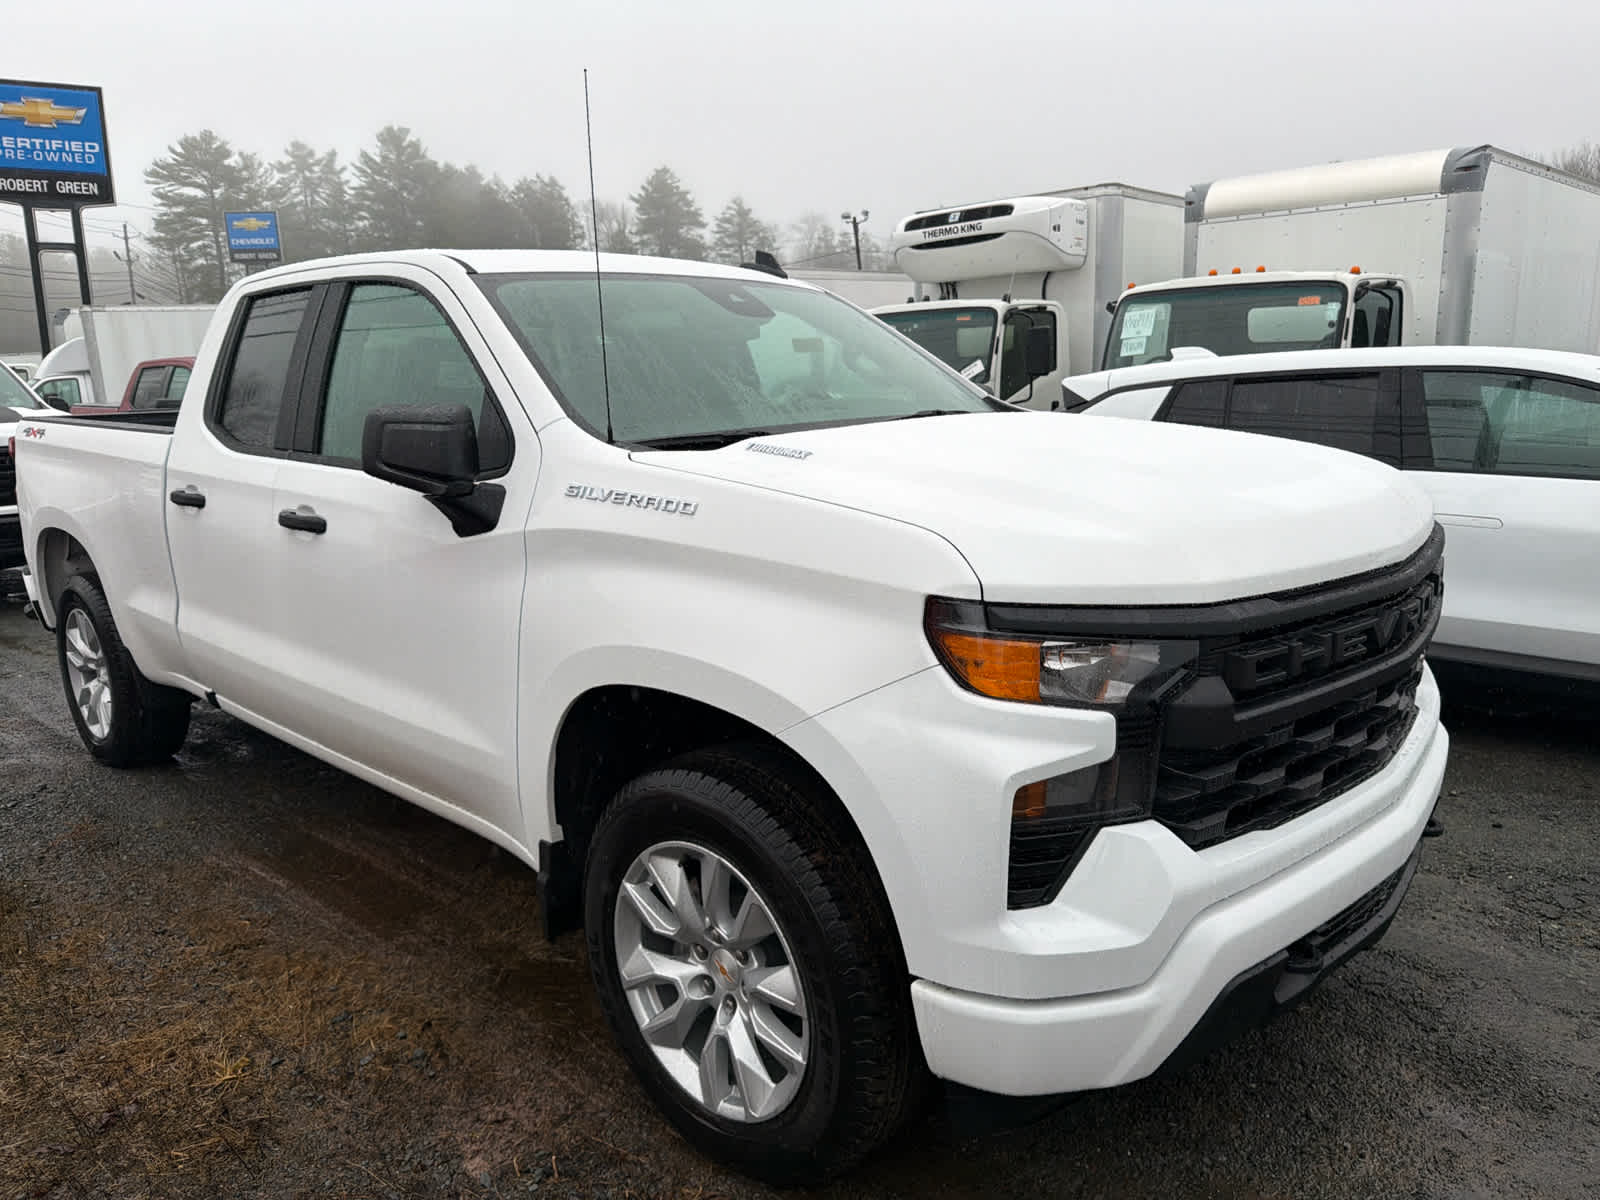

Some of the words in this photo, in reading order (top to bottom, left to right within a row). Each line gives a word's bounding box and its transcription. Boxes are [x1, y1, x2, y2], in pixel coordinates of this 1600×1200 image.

[0, 136, 100, 152] ERTIFIED
[0, 178, 48, 193] ROBERT
[56, 181, 98, 195] GREEN
[922, 225, 959, 240] THERMO
[960, 222, 982, 234] KING
[565, 484, 699, 516] SILVERADO
